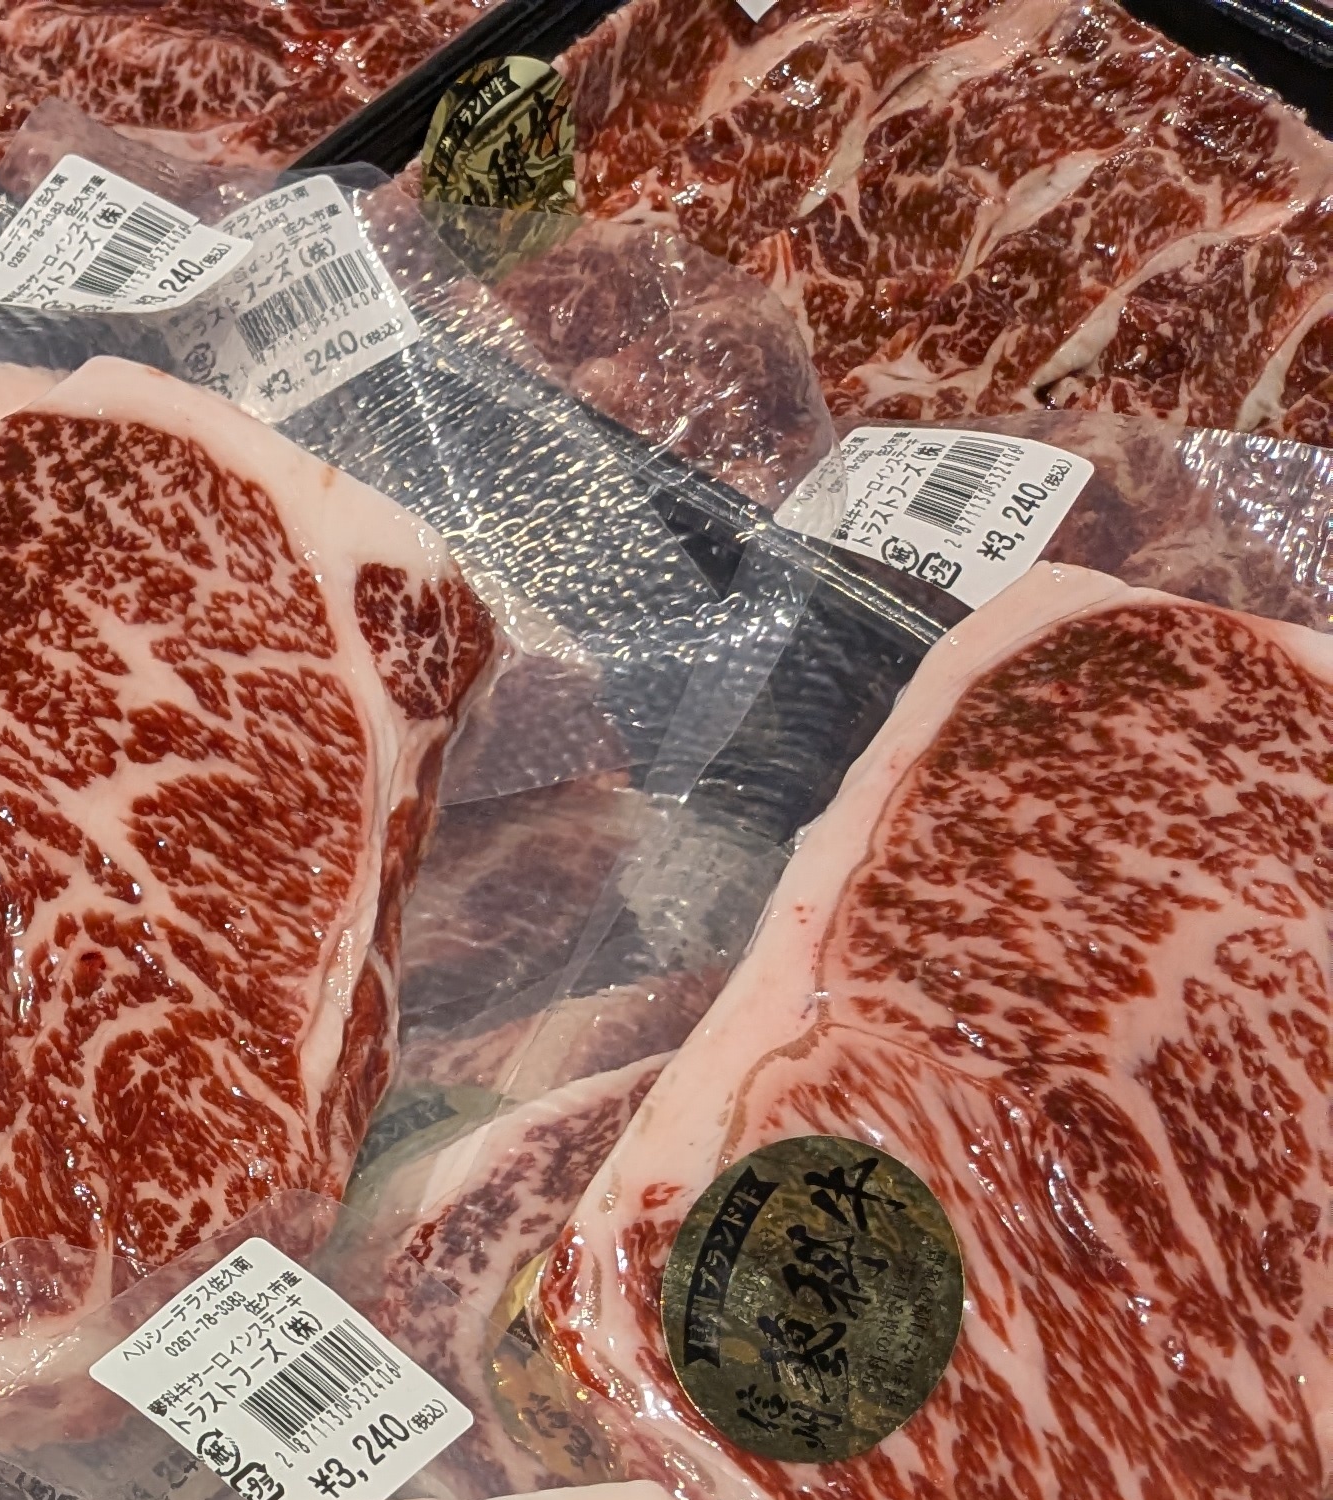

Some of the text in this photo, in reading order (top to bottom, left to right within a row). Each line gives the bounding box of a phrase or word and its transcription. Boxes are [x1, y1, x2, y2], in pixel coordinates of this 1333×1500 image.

[222, 185, 309, 237] テラス佐久南
[123, 1255, 252, 1361] ヘルシーテラス佐久南
[164, 1290, 247, 1357] 0267-78-3383
[244, 1271, 303, 1316] 佐久市産
[147, 1293, 303, 1417] 蓼科牛サーロインステーキ
[307, 1412, 411, 1498] ¥3,240
